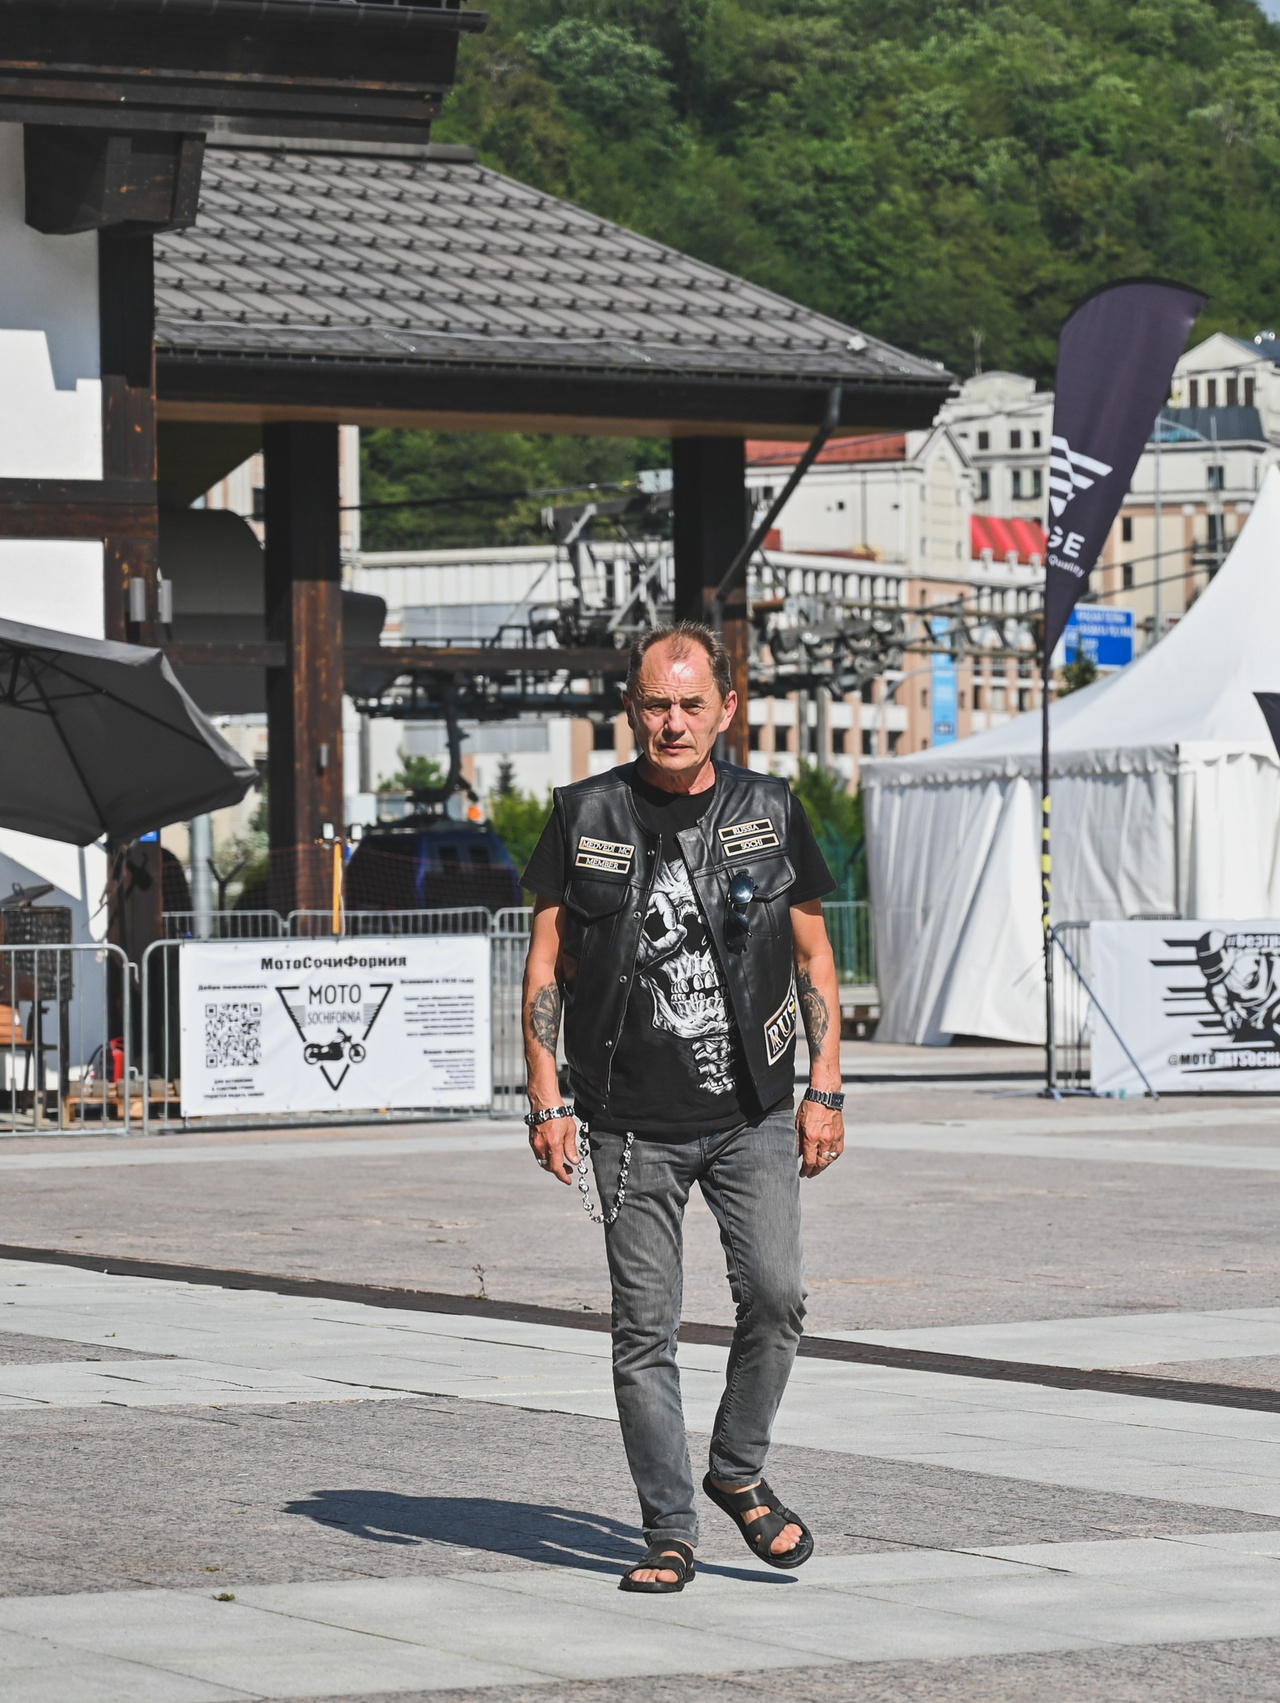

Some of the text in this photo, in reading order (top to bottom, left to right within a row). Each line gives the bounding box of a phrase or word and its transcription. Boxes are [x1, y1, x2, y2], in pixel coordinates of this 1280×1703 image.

[1048, 553, 1085, 578] Quality
[732, 824, 760, 835] RUSSIA
[583, 840, 631, 855] MEDVEDI MC
[740, 838, 763, 850] SOCHI
[586, 857, 619, 870] MEMBER
[261, 955, 407, 970] МотоСочиФорния
[307, 1010, 361, 1026] SOCHIFORNIA
